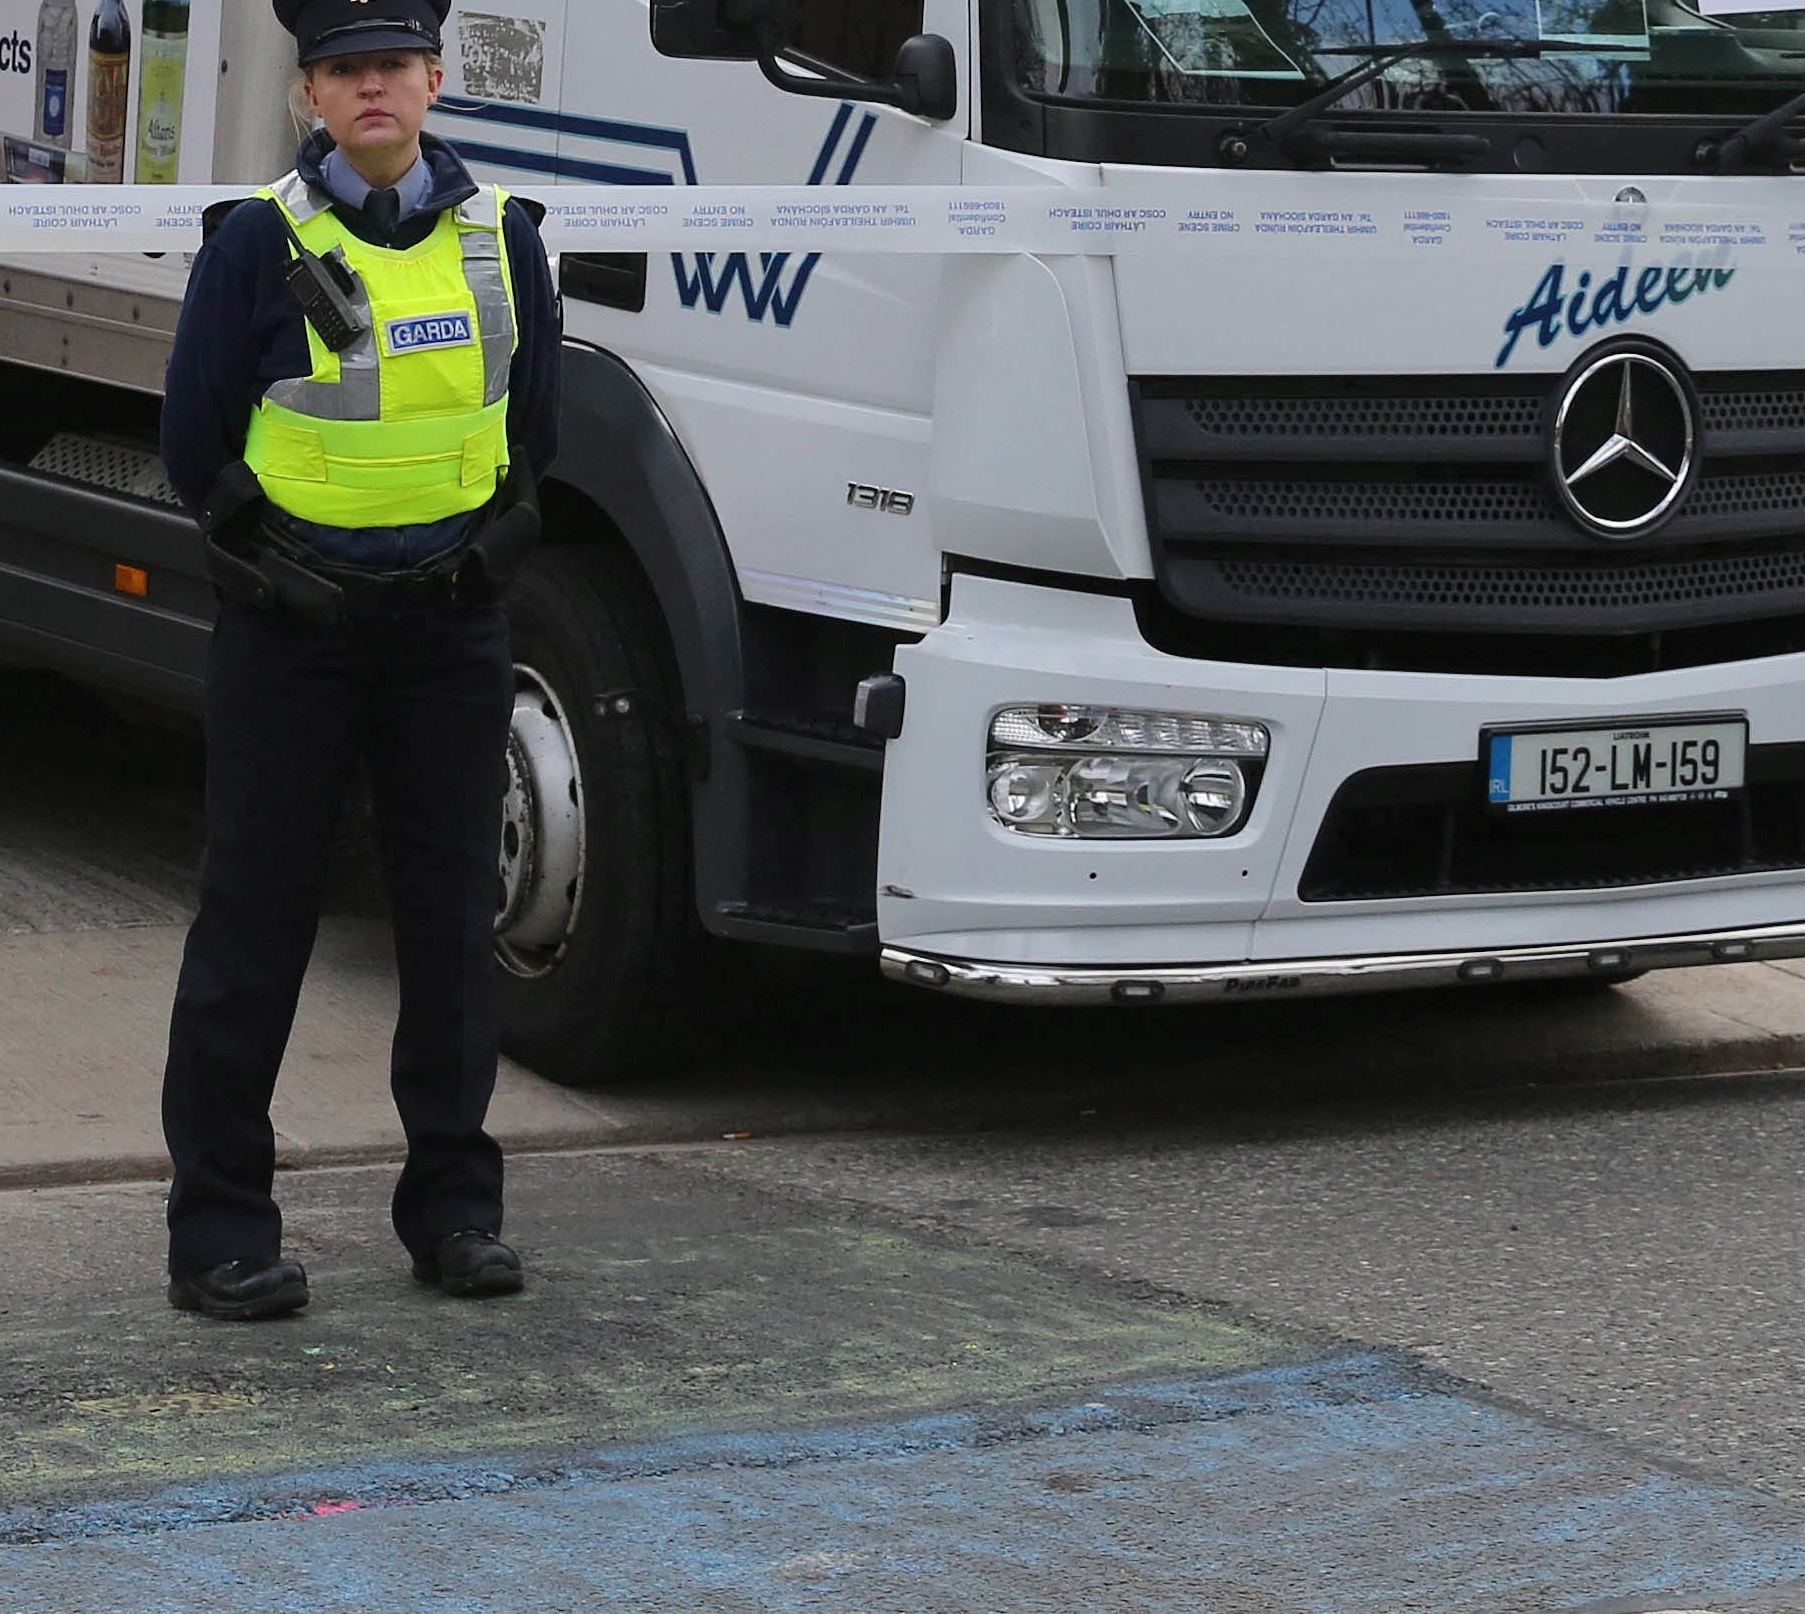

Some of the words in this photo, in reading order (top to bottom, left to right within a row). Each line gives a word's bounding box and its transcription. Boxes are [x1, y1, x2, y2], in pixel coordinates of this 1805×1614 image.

[9, 205, 56, 216] ISTEACH
[57, 205, 89, 216] DHUL
[91, 205, 109, 217] AR
[110, 205, 141, 215] COSC
[167, 205, 203, 215] ENTRY
[546, 205, 586, 215] ISTEAC
[588, 205, 618, 216] DHUL
[620, 205, 636, 215] AR
[638, 205, 668, 215] COSC
[692, 206, 727, 215] ENTRY
[729, 205, 745, 215] NO
[831, 204, 871, 215] GARDA
[872, 204, 887, 214] AN
[33, 217, 68, 228] COIRE
[156, 217, 193, 227] SCENE
[564, 217, 597, 227] COIRE
[682, 217, 718, 227] SCENE
[720, 218, 754, 227] CRIME
[879, 215, 916, 226] UIMHIR
[948, 213, 1006, 224] Confidential
[958, 226, 996, 236] GARDA
[393, 319, 469, 346] GARDA
[845, 481, 915, 516] 1318
[1540, 738, 1720, 796] 152-LM-159
